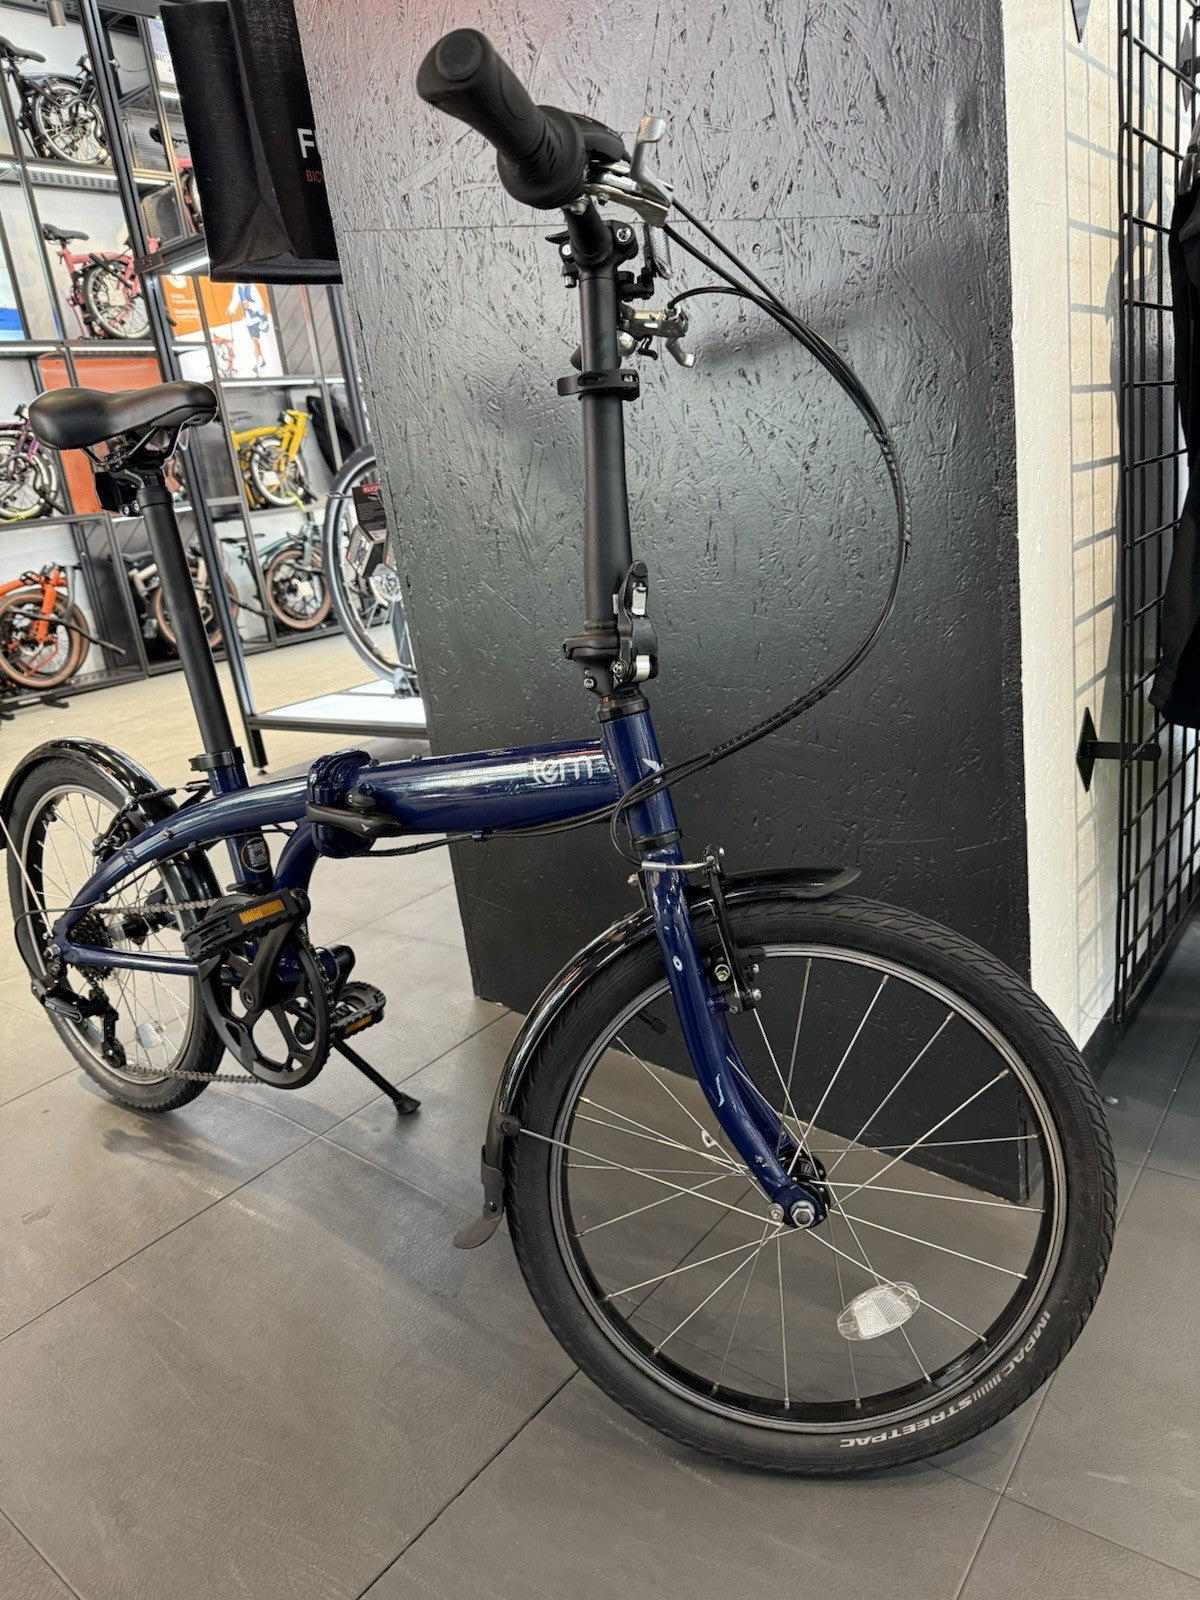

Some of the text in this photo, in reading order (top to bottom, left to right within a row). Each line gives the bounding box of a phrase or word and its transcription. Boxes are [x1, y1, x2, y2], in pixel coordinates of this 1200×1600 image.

[297, 128, 317, 159] F
[532, 757, 594, 785] tern
[840, 1310, 1051, 1448] IMPAC STREETPAC
